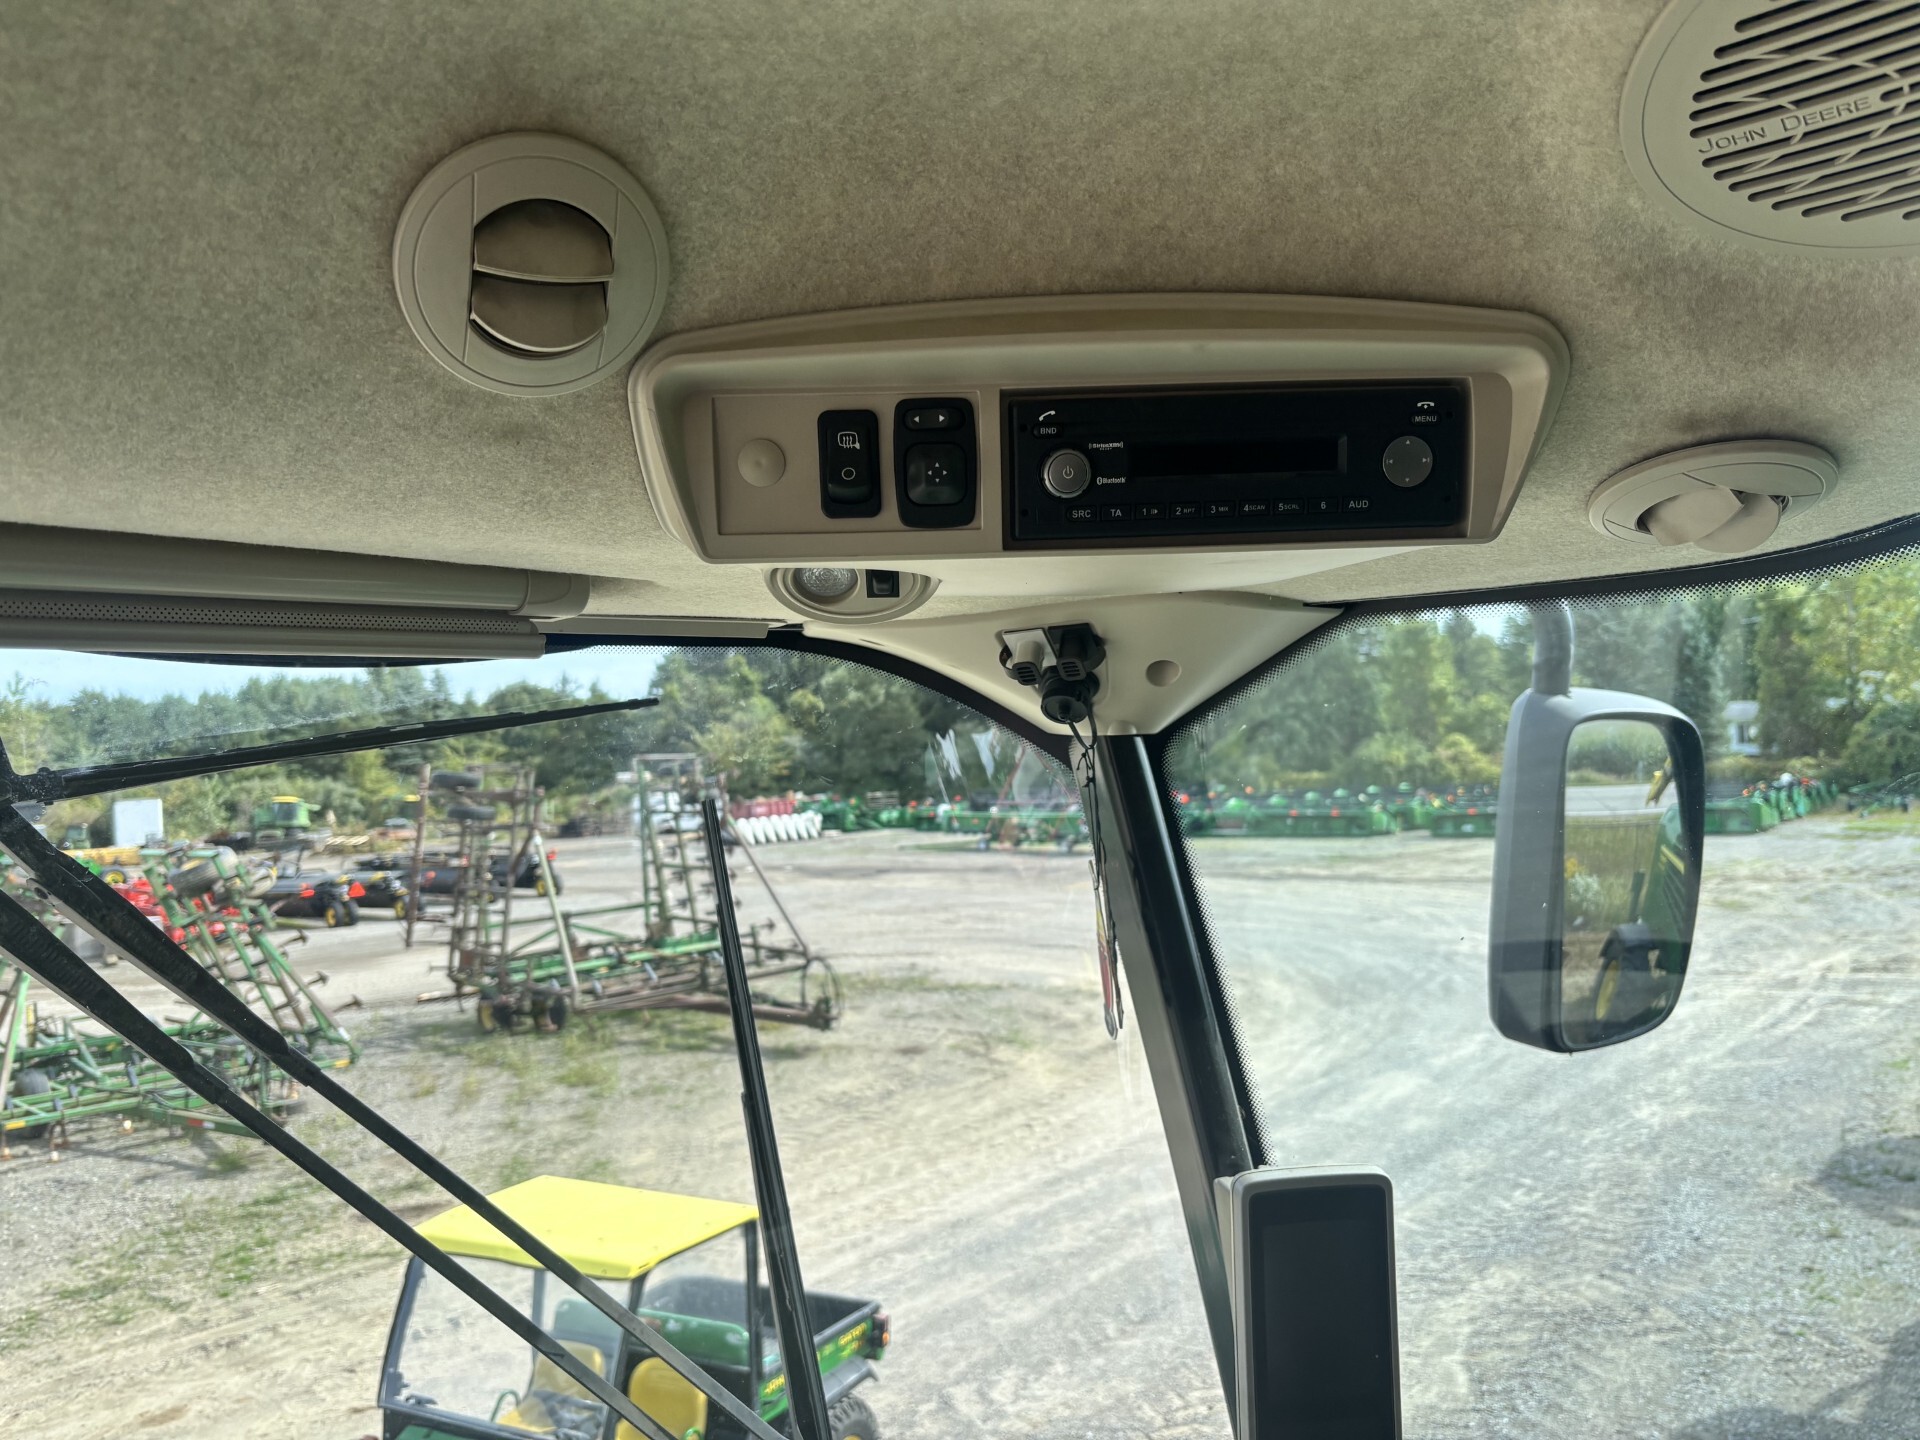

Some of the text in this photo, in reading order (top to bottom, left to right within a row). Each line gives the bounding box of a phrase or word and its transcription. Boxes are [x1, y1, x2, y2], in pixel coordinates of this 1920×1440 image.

[1698, 96, 1873, 153] JOHN DEERE
[1040, 427, 1057, 435] BND
[1320, 501, 1327, 510] 6
[1348, 500, 1369, 509] AUD
[1072, 509, 1091, 518] SRC
[1110, 508, 1122, 517] TA
